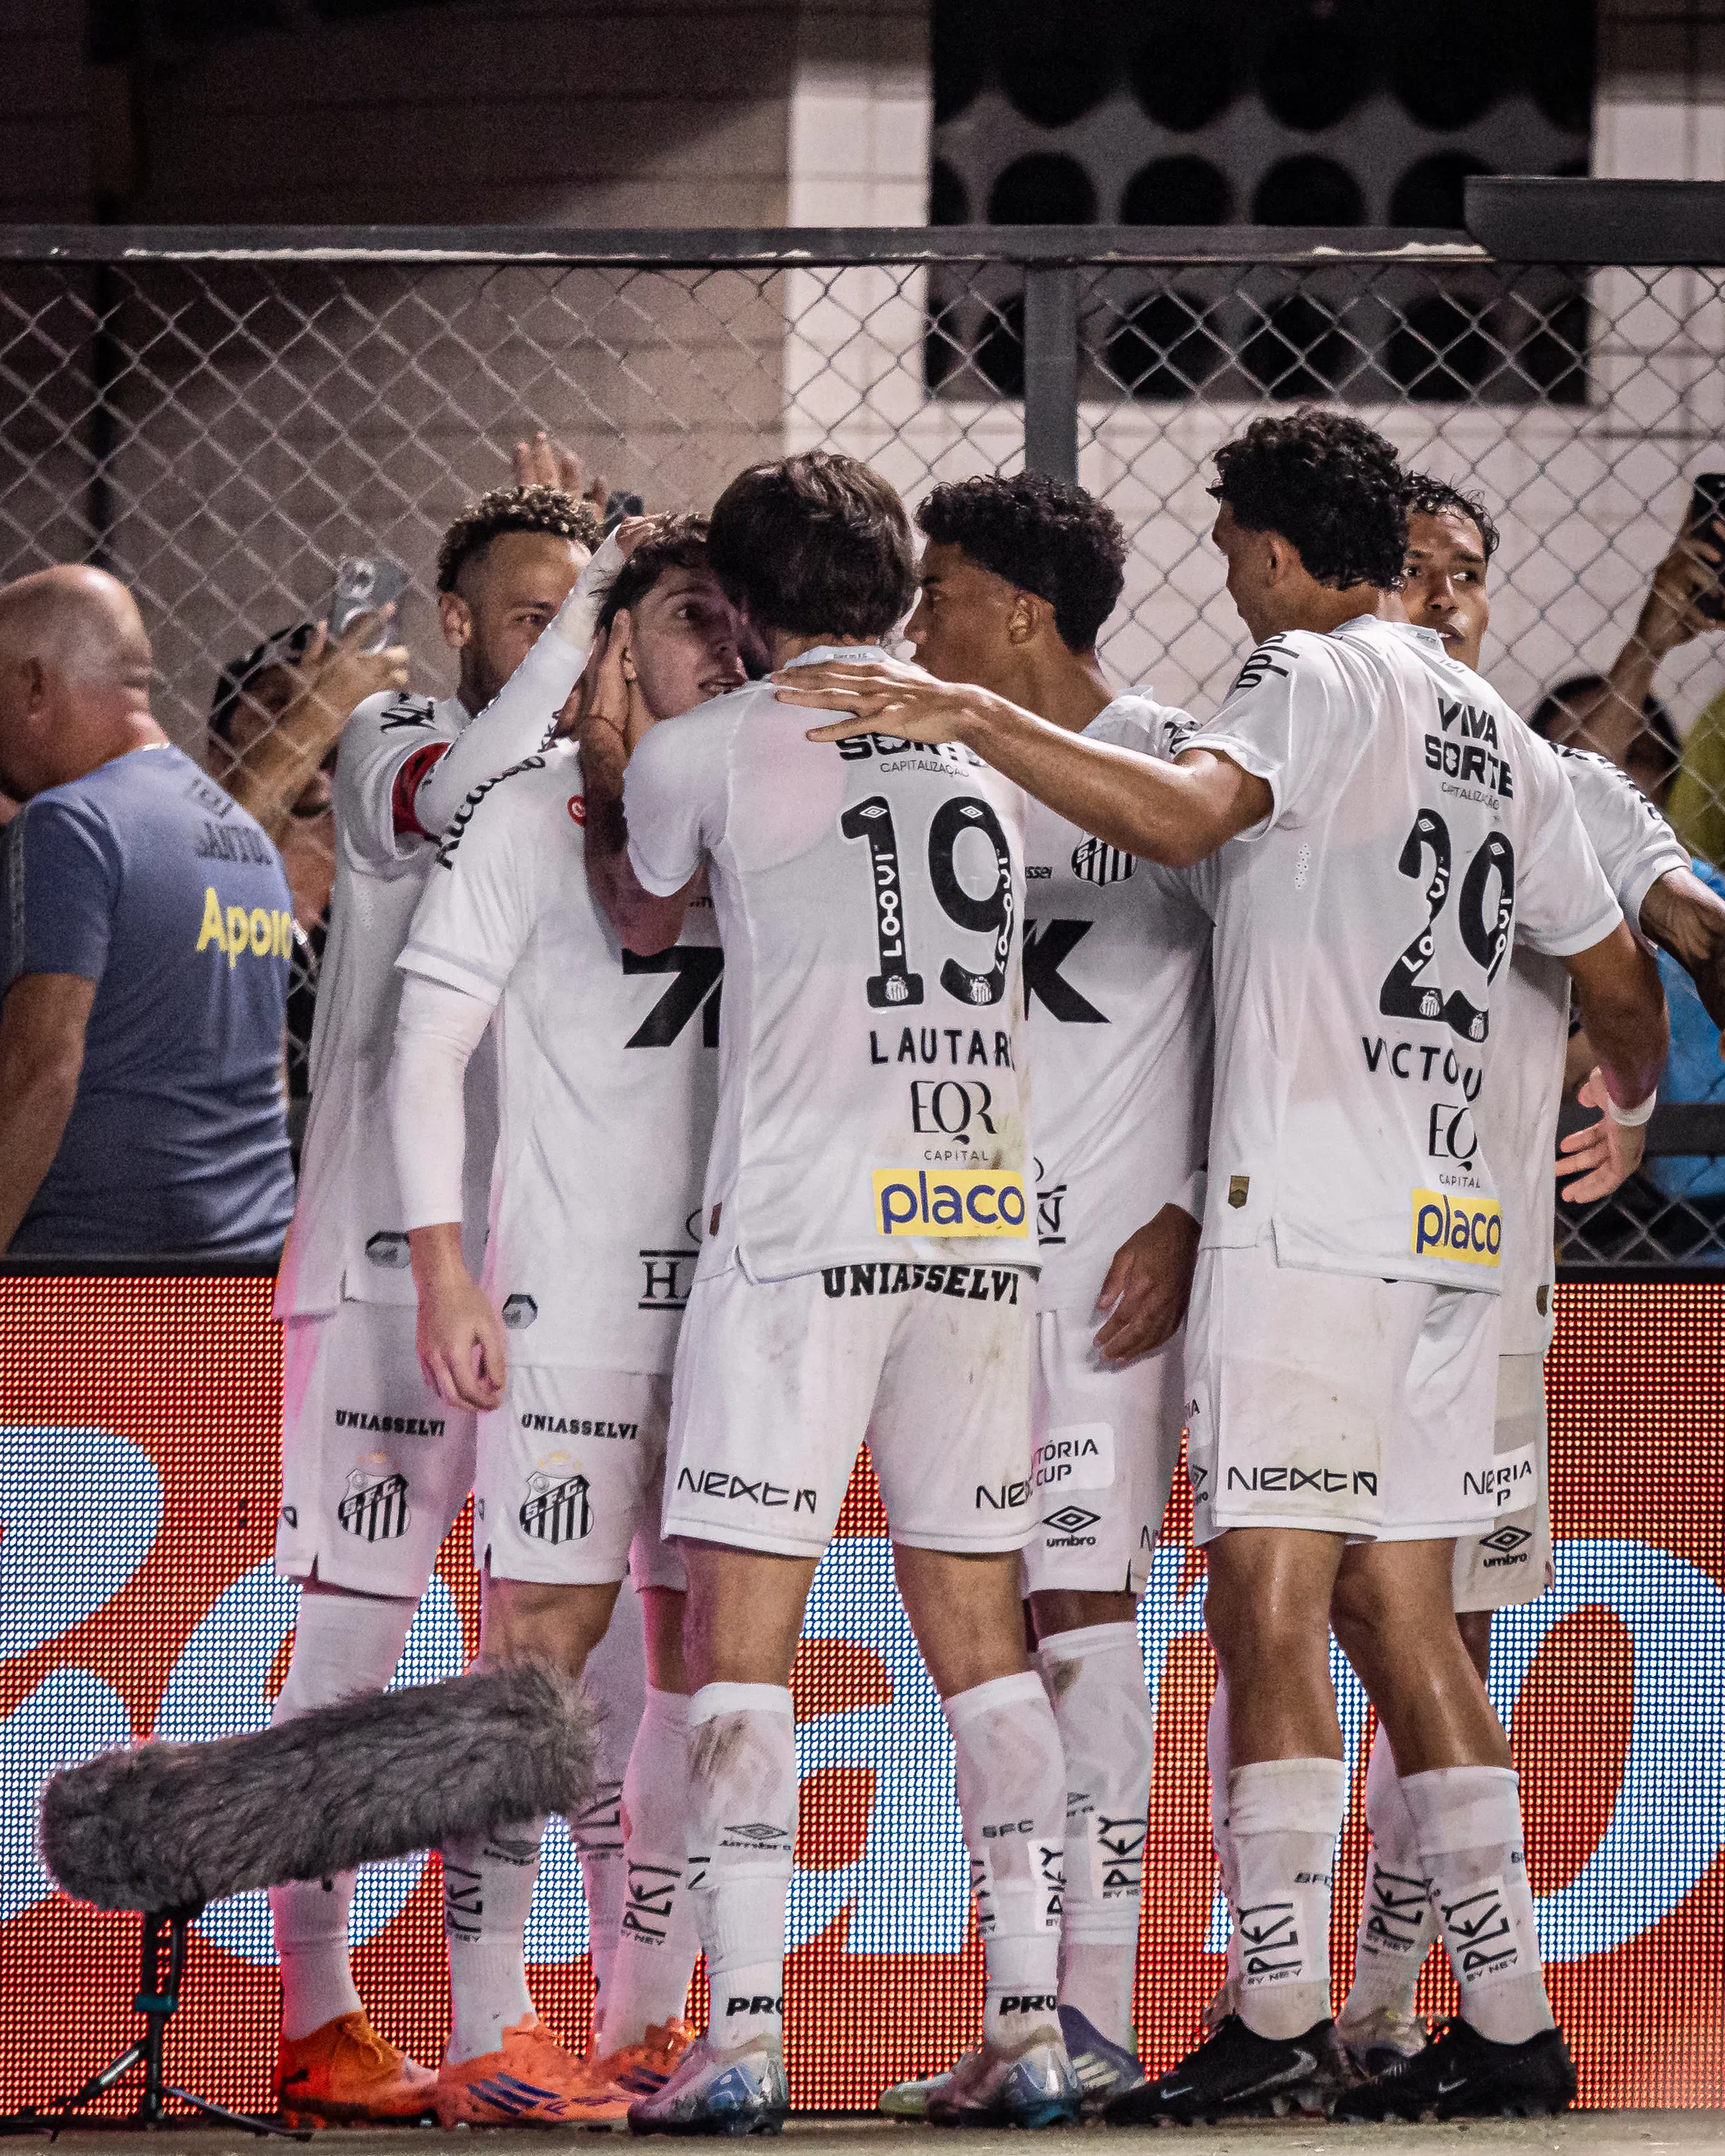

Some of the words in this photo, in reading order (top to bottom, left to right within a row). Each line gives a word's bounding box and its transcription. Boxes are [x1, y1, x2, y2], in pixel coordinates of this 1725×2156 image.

[1438, 698, 1499, 750] VIVA
[1425, 734, 1514, 799] SORTE
[840, 796, 1014, 1007] 19
[1379, 808, 1514, 1044] 20
[924, 1150, 990, 1161] CAPITAL
[881, 1170, 1026, 1235] placo
[1439, 1174, 1481, 1189] CAPITAL
[1416, 1194, 1502, 1255] placo
[822, 1263, 1019, 1305] UNIASSELVI
[335, 1409, 445, 1437] UNIASSELVI
[521, 1414, 638, 1439] UNIASSELVI
[1046, 1534, 1097, 1548] umbro
[1483, 1552, 1528, 1568] umbro
